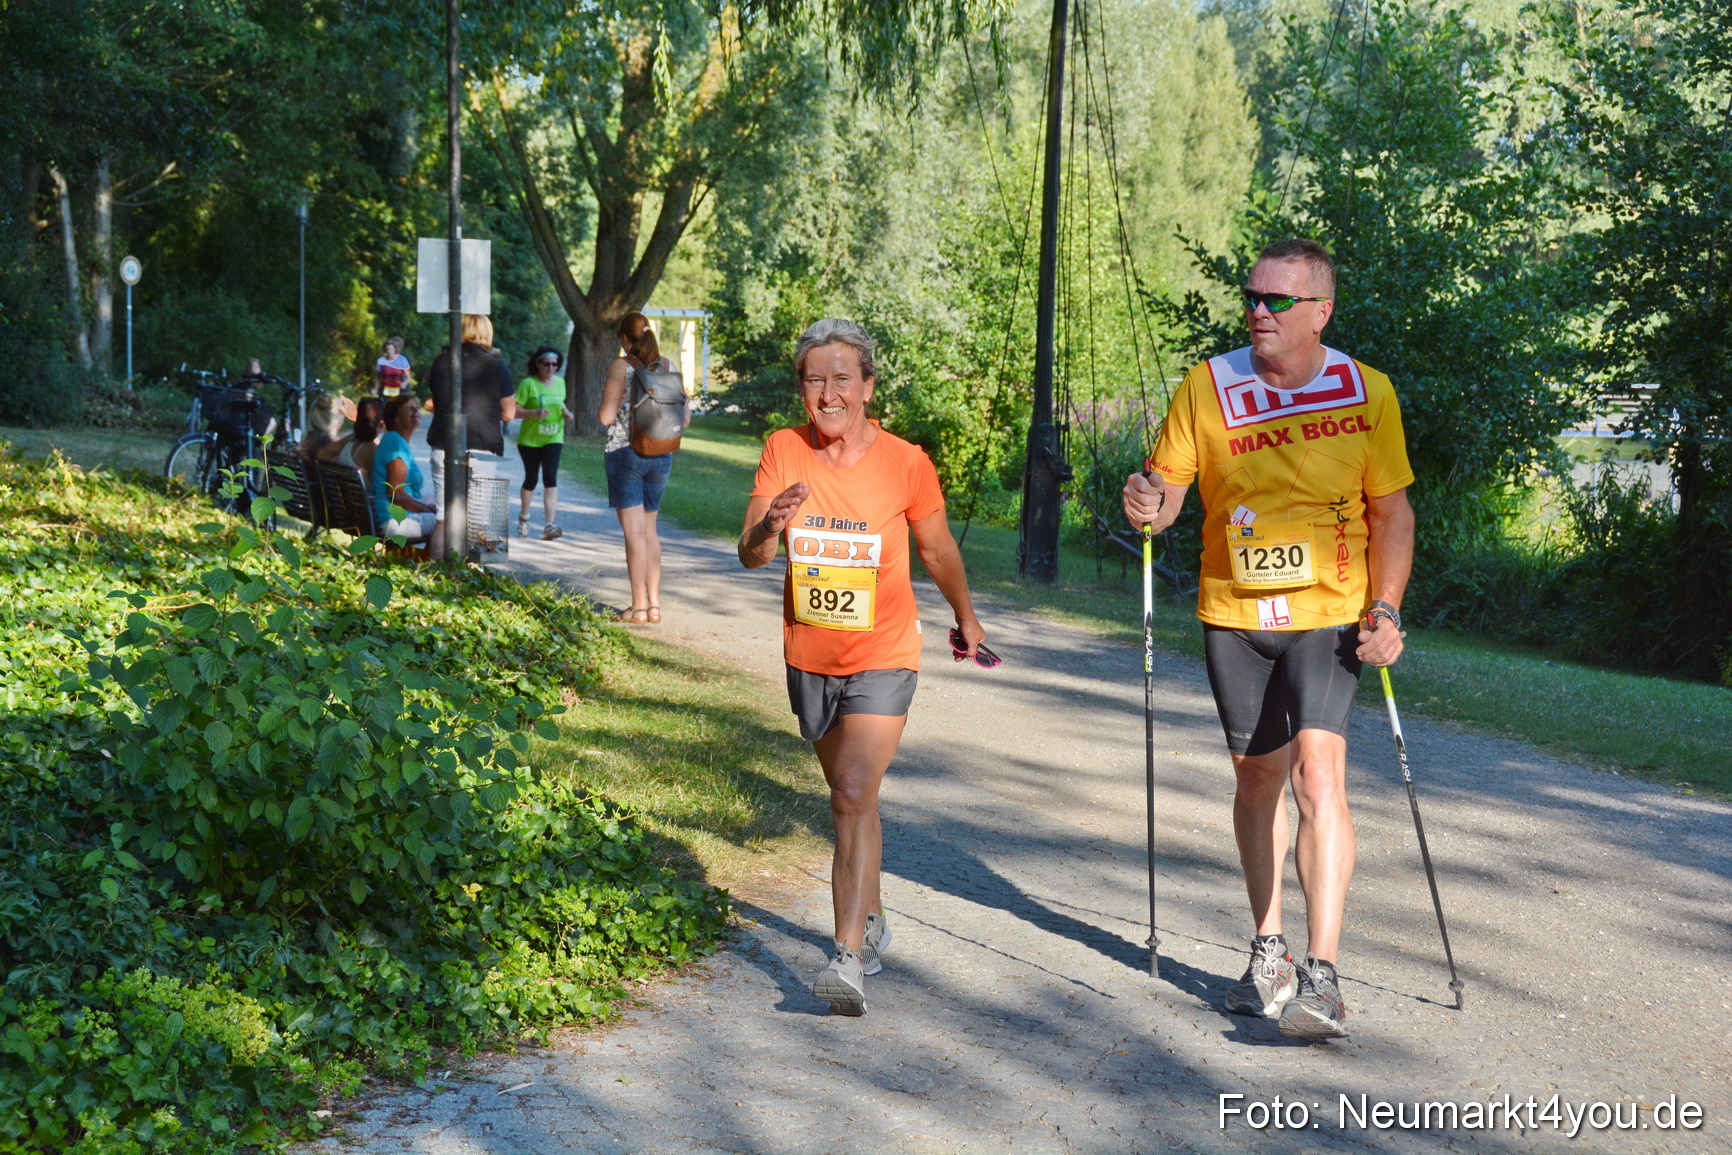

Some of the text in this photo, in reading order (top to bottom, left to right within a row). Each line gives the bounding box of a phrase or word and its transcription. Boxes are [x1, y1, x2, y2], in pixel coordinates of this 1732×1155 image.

[1228, 414, 1372, 457] MAX BÖGL
[804, 514, 867, 532] 30 Jahre
[793, 536, 874, 560] OBI
[1239, 545, 1304, 571] 1230
[1274, 569, 1299, 577] Eduard
[809, 587, 855, 612] 892
[807, 609, 858, 620] Zrenner Susanna
[1145, 634, 1153, 672] FLASH
